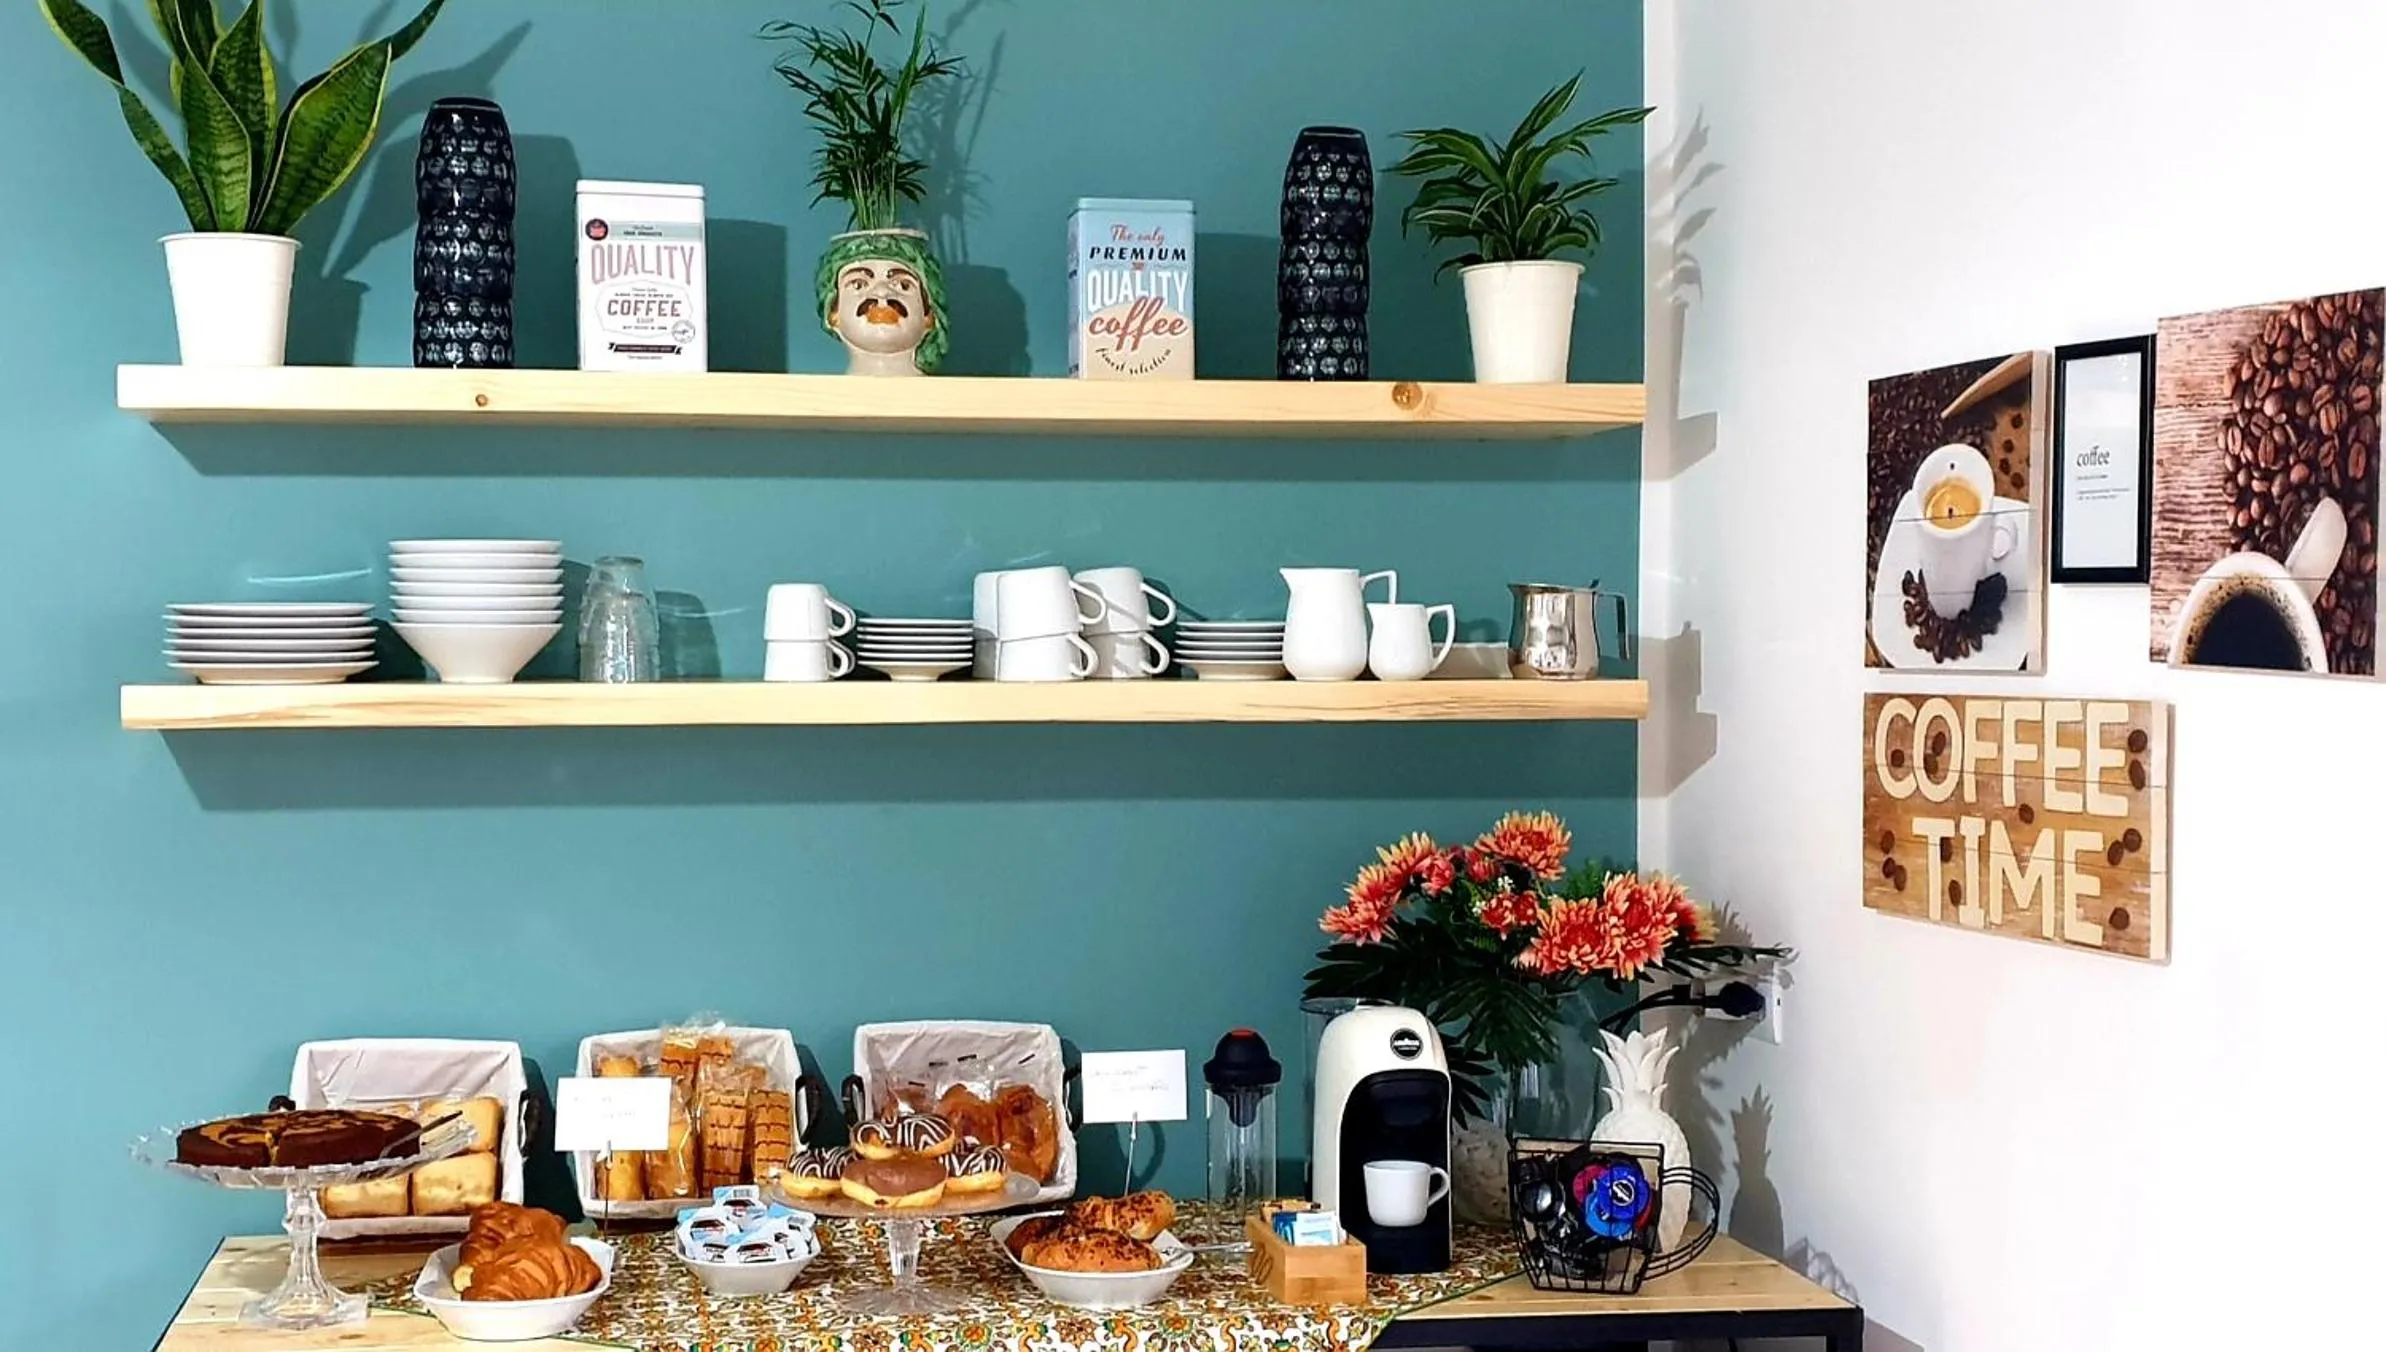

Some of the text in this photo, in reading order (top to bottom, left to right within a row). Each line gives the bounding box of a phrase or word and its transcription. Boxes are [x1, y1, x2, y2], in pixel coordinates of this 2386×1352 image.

[1089, 246, 1187, 261] PREMIUM
[1110, 223, 1165, 247] The only
[591, 243, 695, 285] QUALITY
[607, 299, 682, 317] COFFEE
[1087, 268, 1189, 313] QUALITY
[1089, 296, 1188, 351] coffee
[2076, 445, 2110, 467] coffee
[1875, 697, 2130, 817] COFFEE
[1911, 815, 2104, 947] TIME
